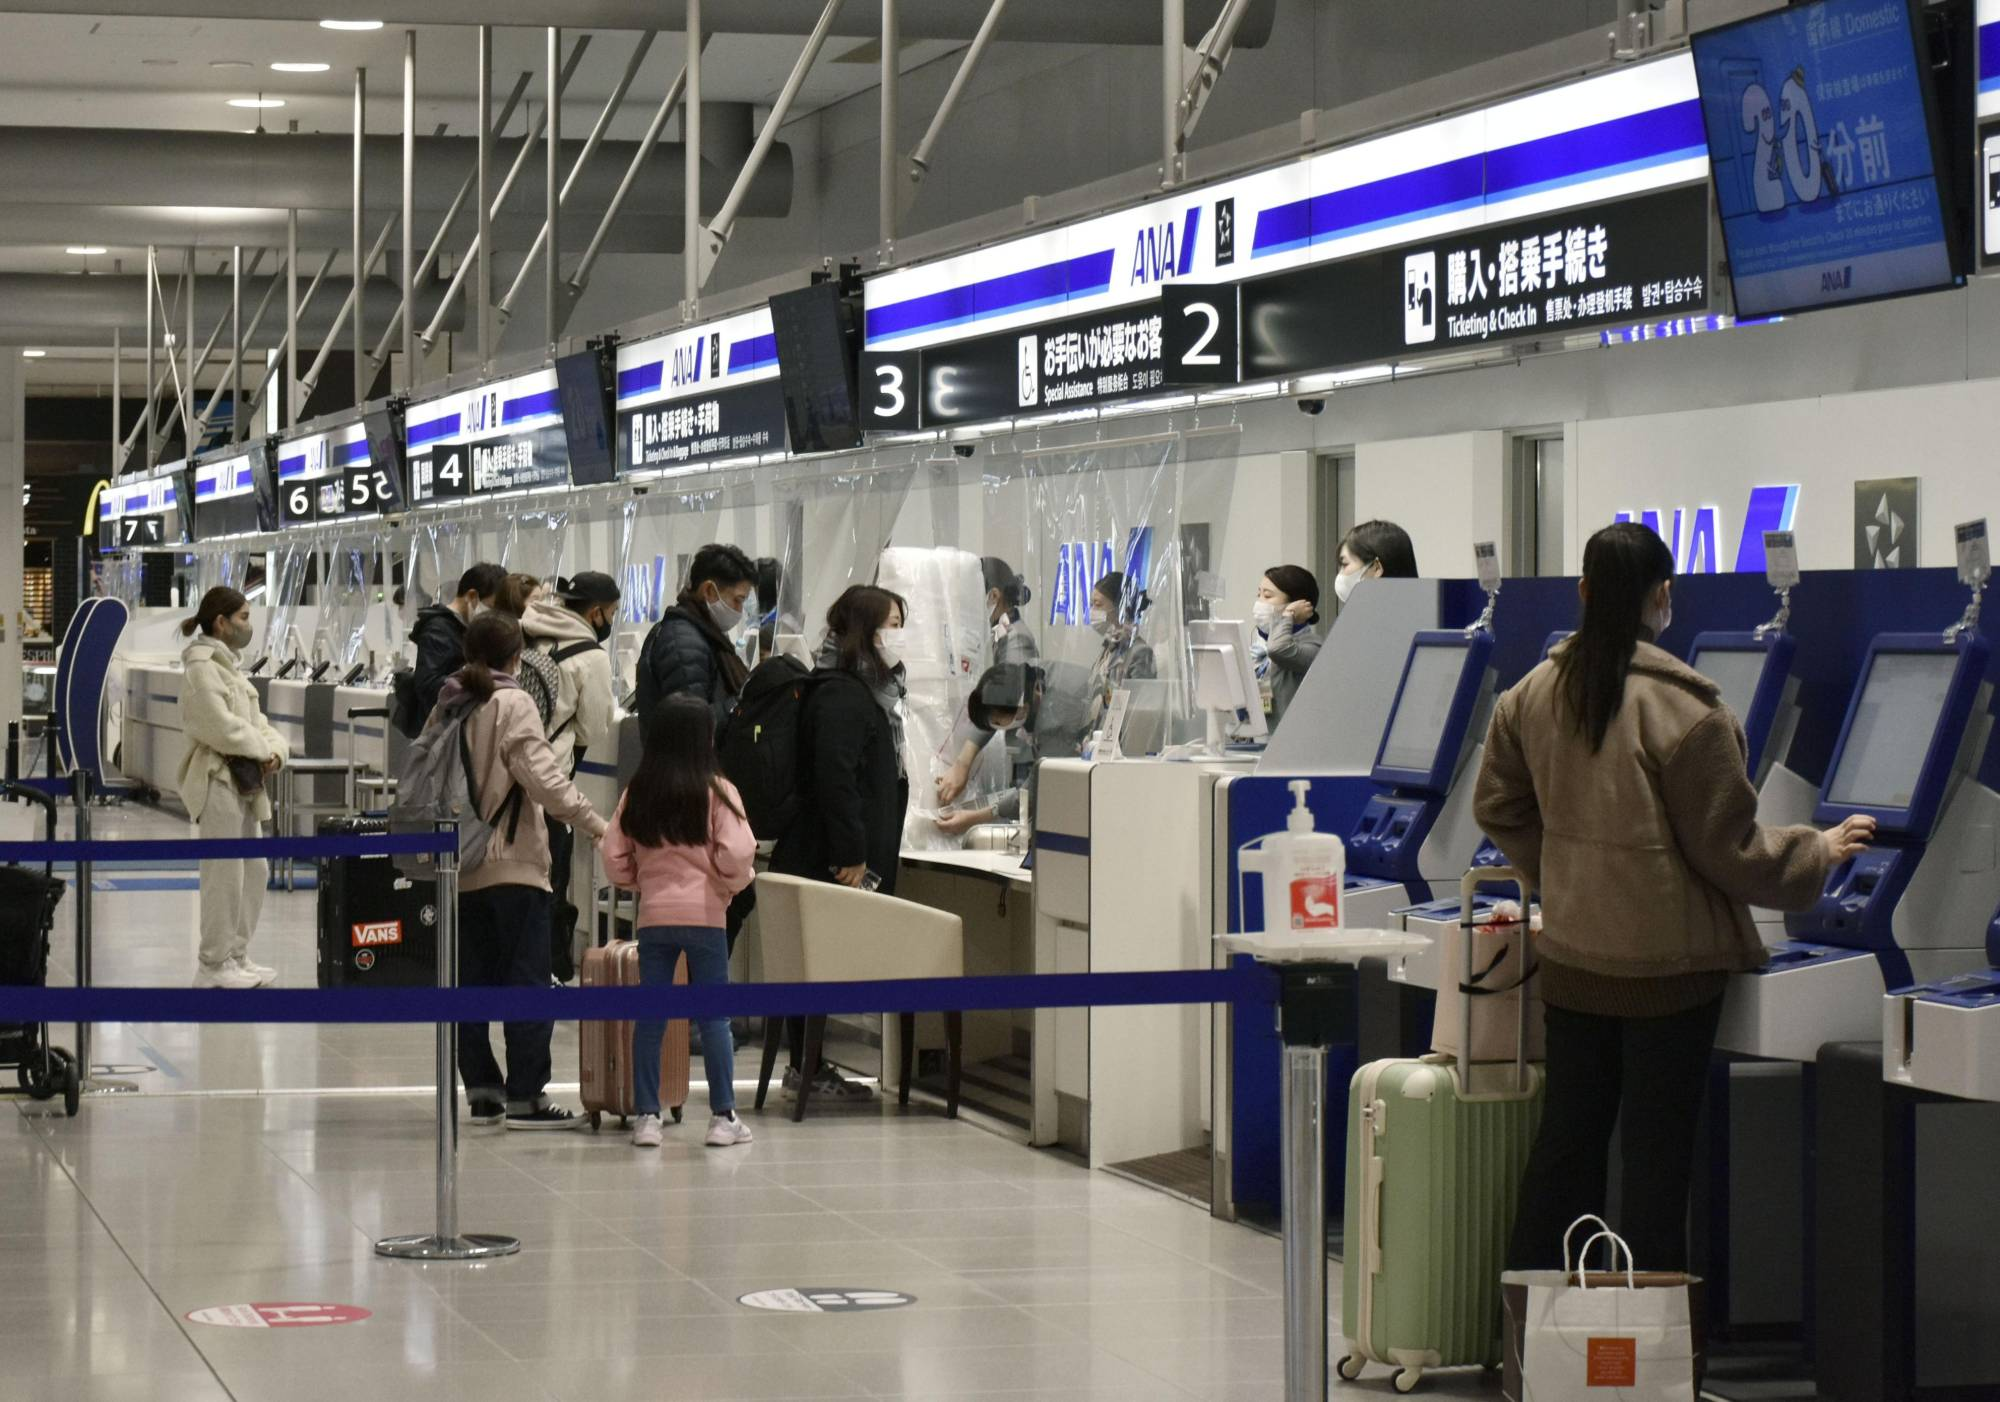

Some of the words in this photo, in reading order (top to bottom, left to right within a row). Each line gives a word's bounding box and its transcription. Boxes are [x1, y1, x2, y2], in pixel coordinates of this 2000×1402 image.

[1846, 2, 1899, 34] Domestic
[1131, 221, 1175, 287] ANA
[1447, 224, 1608, 306] 購入・搭乗手続き
[1819, 270, 1843, 291] ANA
[1181, 302, 1221, 365] 2
[1448, 311, 1488, 339] Ticketing
[1489, 312, 1497, 331] &
[1498, 306, 1528, 328] Check
[1529, 304, 1537, 326] In
[671, 345, 693, 388] ANA
[873, 364, 905, 417] 3
[1044, 381, 1063, 406] Special
[1064, 380, 1094, 400] Assistance
[1149, 369, 1163, 388] 필요
[440, 453, 463, 487] 4
[290, 486, 308, 515] 6
[352, 475, 370, 505] 5
[125, 520, 138, 541] 7
[353, 921, 399, 944] VANS
